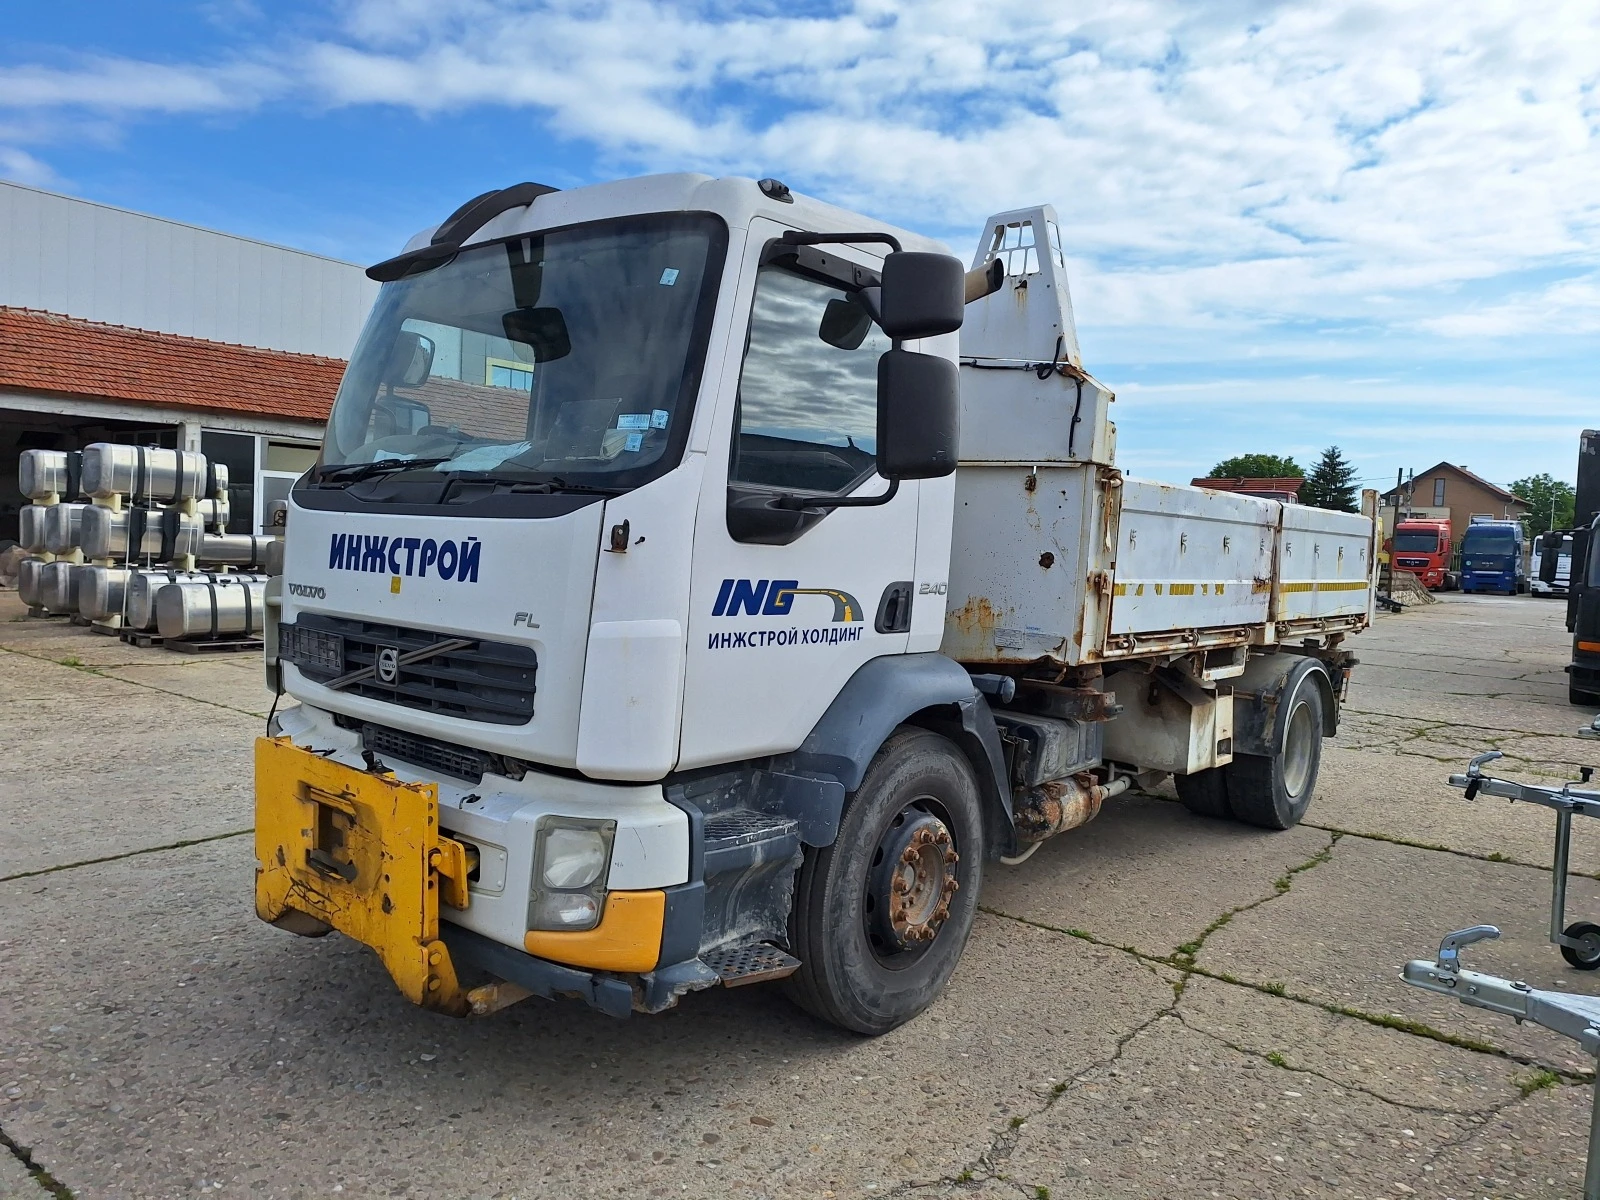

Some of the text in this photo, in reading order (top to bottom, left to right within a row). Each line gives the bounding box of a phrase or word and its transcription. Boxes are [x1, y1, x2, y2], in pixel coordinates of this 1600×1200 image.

[329, 533, 481, 583] ИНЖСТРОЙ
[288, 583, 326, 599] VOLVO
[711, 579, 799, 616] ING
[918, 582, 947, 596] 240
[513, 612, 540, 629] FL
[708, 626, 864, 650] ИНЖСТРОЙ ХОЛДИНГ
